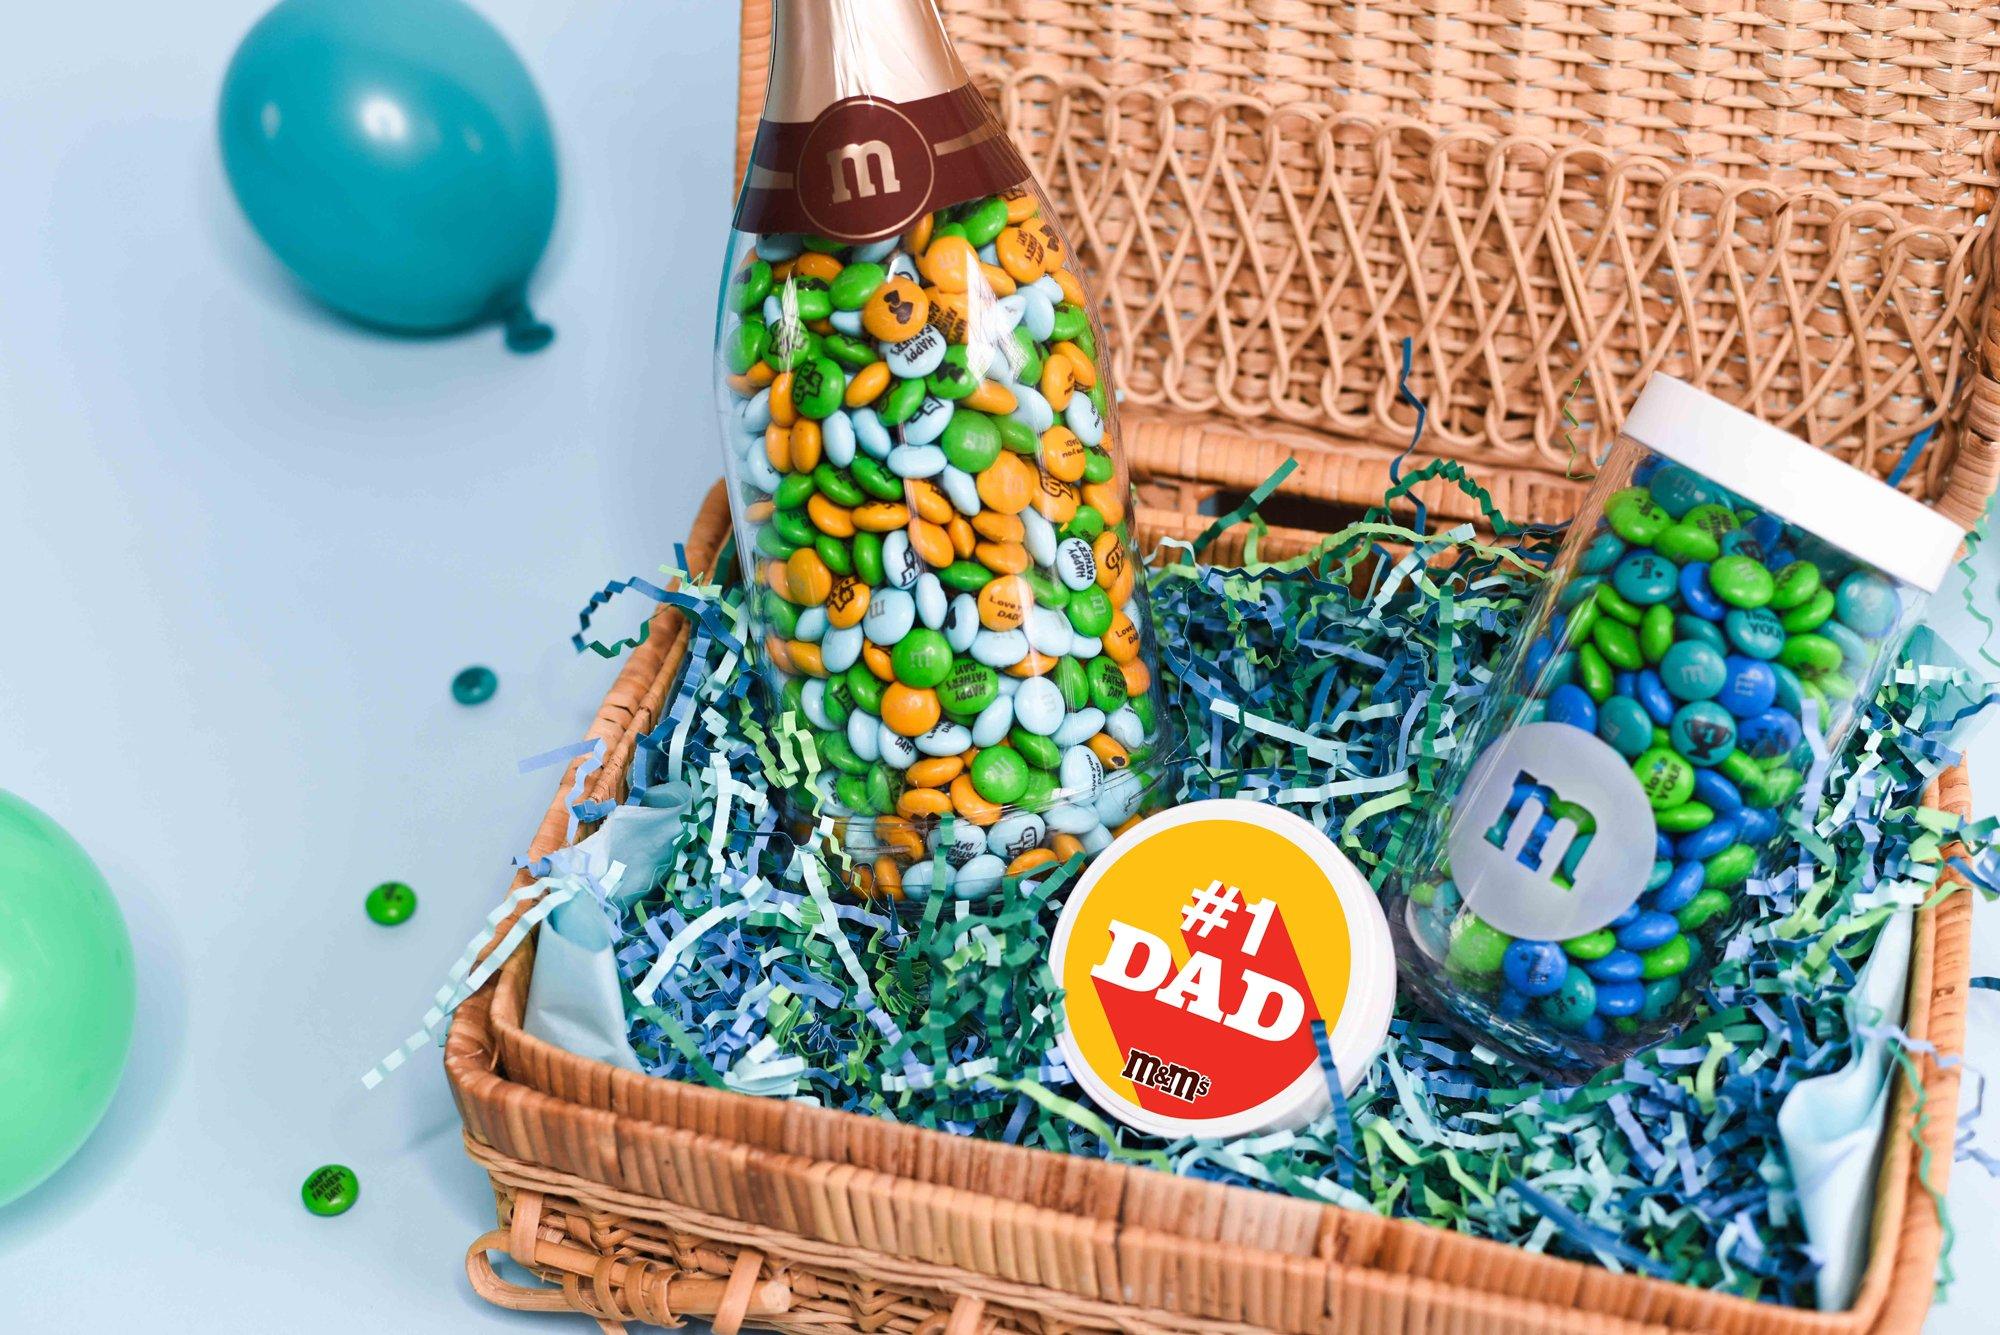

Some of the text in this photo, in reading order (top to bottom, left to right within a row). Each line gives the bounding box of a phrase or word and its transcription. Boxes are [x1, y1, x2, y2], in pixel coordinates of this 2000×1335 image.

[827, 140, 900, 203] m
[904, 335, 938, 365] HAPPY
[1067, 548, 1086, 578] HAPPY
[895, 736, 913, 756] DAY!
[1085, 754, 1096, 771] you
[1484, 769, 1597, 891] m
[1180, 879, 1277, 957] #1
[1090, 918, 1306, 1042] DAD
